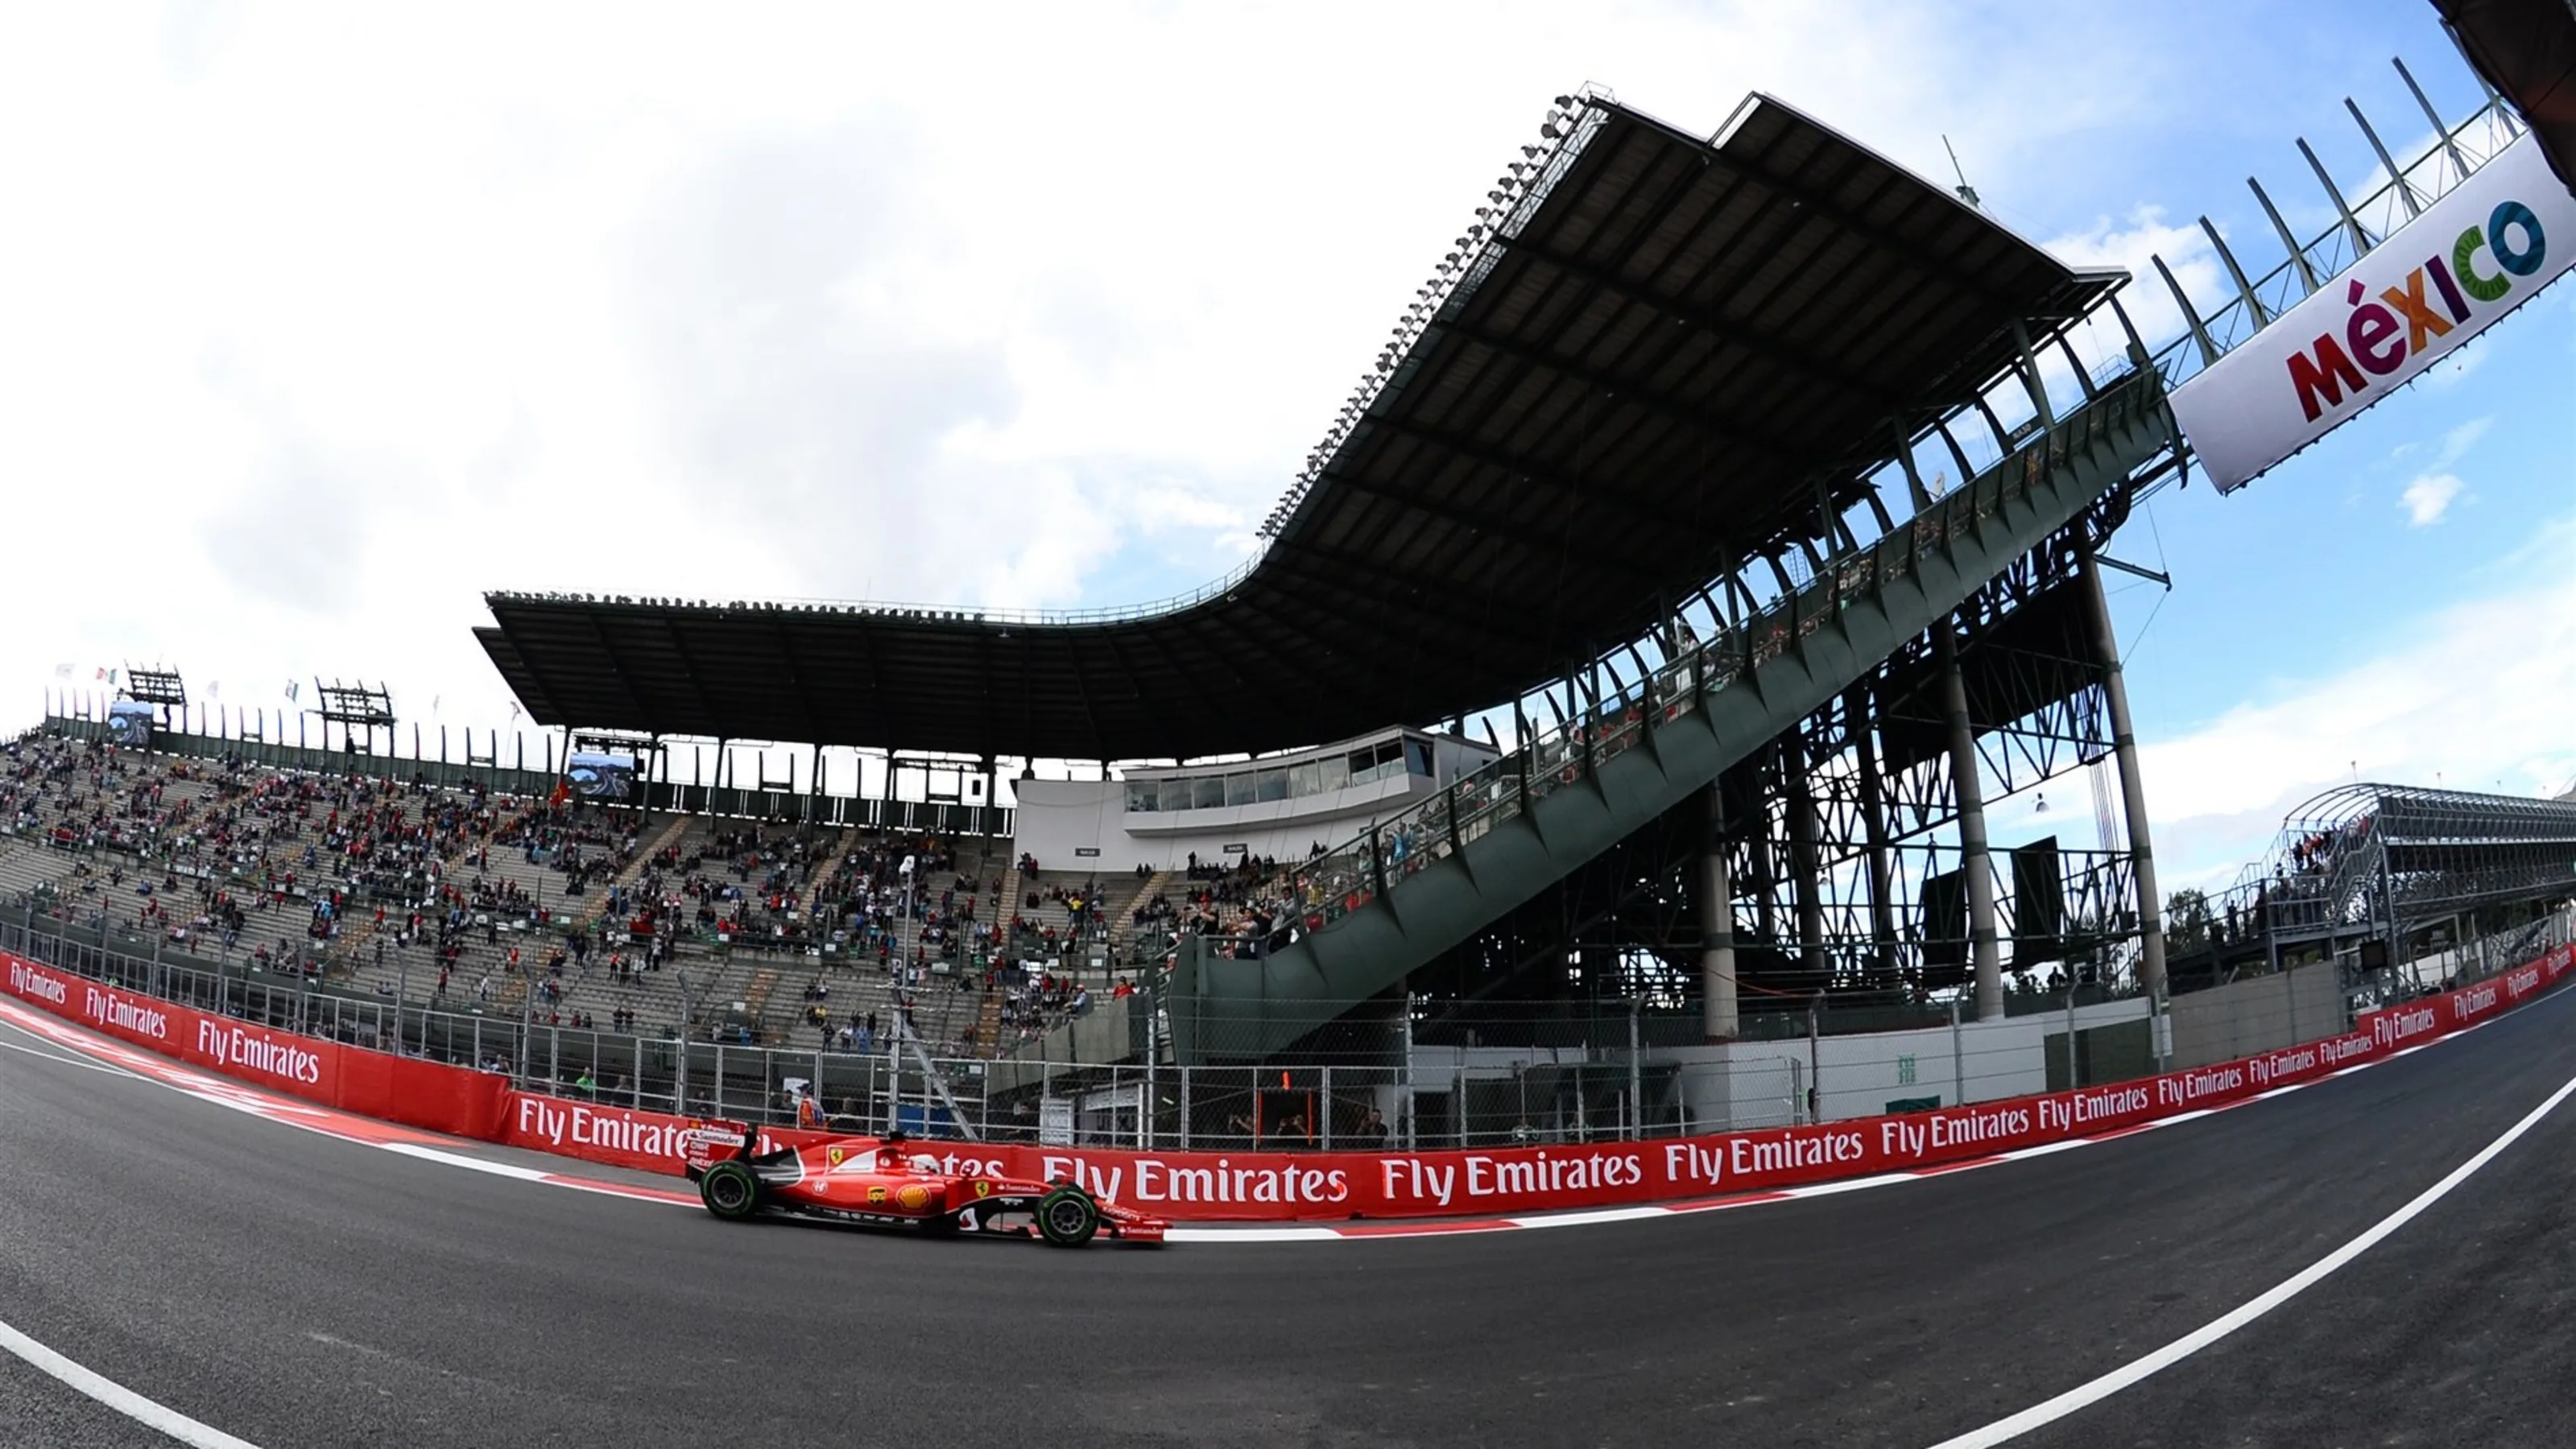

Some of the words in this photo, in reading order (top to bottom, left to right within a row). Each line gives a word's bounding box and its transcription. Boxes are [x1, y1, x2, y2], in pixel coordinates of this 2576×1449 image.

[10, 962, 26, 994] Fly
[26, 968, 66, 1005] Emirates
[2454, 995, 2468, 1021] Fly
[2467, 988, 2495, 1013] Emirates
[86, 987, 105, 1026] Fly
[107, 993, 166, 1038] Emirates
[2374, 1016, 2393, 1048] Fly
[2393, 1007, 2434, 1039] Emirates
[199, 1020, 229, 1065] Fly
[231, 1030, 319, 1084] Emirates
[2249, 1059, 2269, 1085] Fly
[2270, 1050, 2315, 1077] Emirates
[2320, 1042, 2336, 1066] Fly
[2337, 1034, 2373, 1059] Emirates
[2158, 1078, 2183, 1106] Fly
[2185, 1067, 2242, 1098] Emirates
[519, 1098, 565, 1146] Fly
[573, 1107, 688, 1159] Emirate
[2038, 1100, 2070, 1131] Fly
[2074, 1088, 2148, 1121] Emirates
[1881, 1121, 1925, 1158] Fly
[1930, 1108, 2029, 1147] Emirates
[1135, 1158, 1347, 1203] Emirates
[1382, 1159, 1454, 1206] Fly
[1465, 1152, 1642, 1196] Emirates
[1664, 1144, 1723, 1186] Fly
[1730, 1132, 1864, 1174] Emirates
